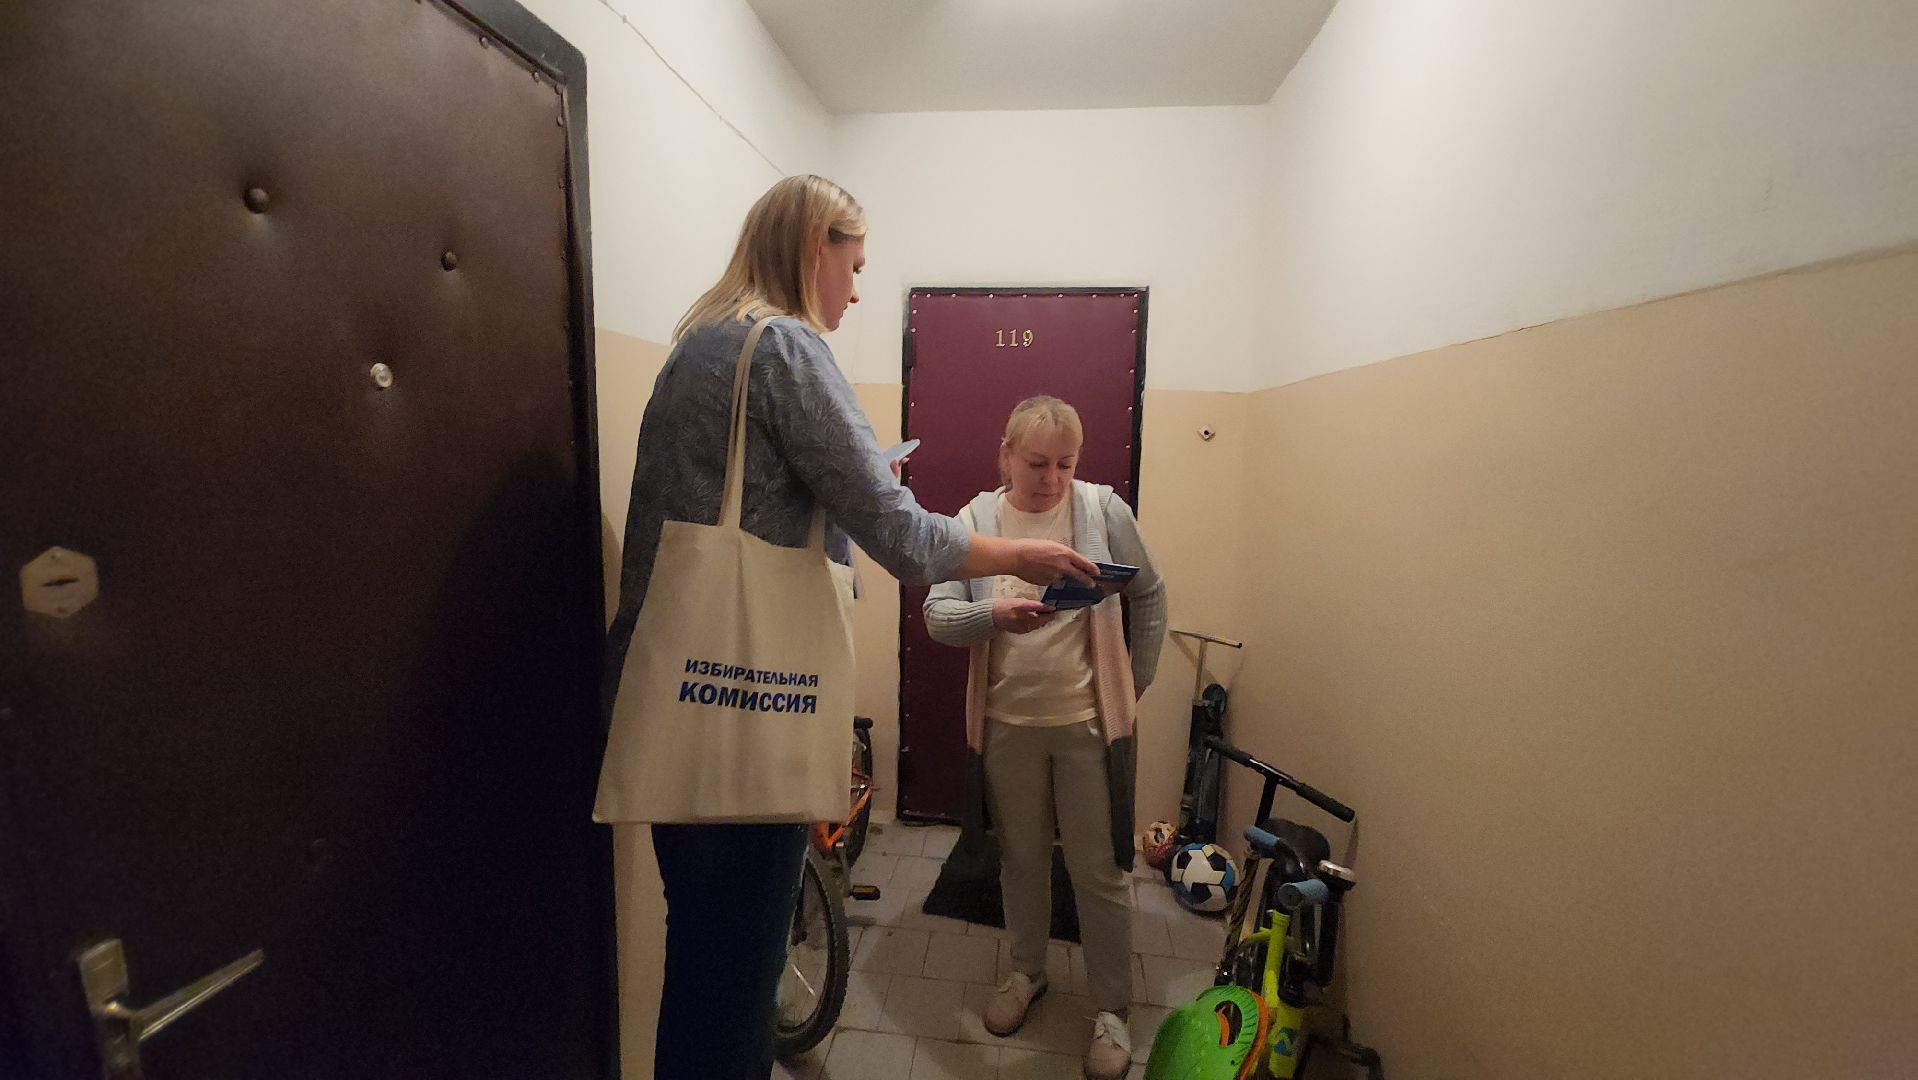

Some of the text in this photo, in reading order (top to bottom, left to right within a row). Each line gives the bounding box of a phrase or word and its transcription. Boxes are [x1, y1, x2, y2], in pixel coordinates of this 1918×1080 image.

[995, 329, 1034, 347] 119
[684, 659, 819, 687] ИЗБИРАТЕЛЬНАЯ
[679, 681, 817, 714] КОМИССИЯ
